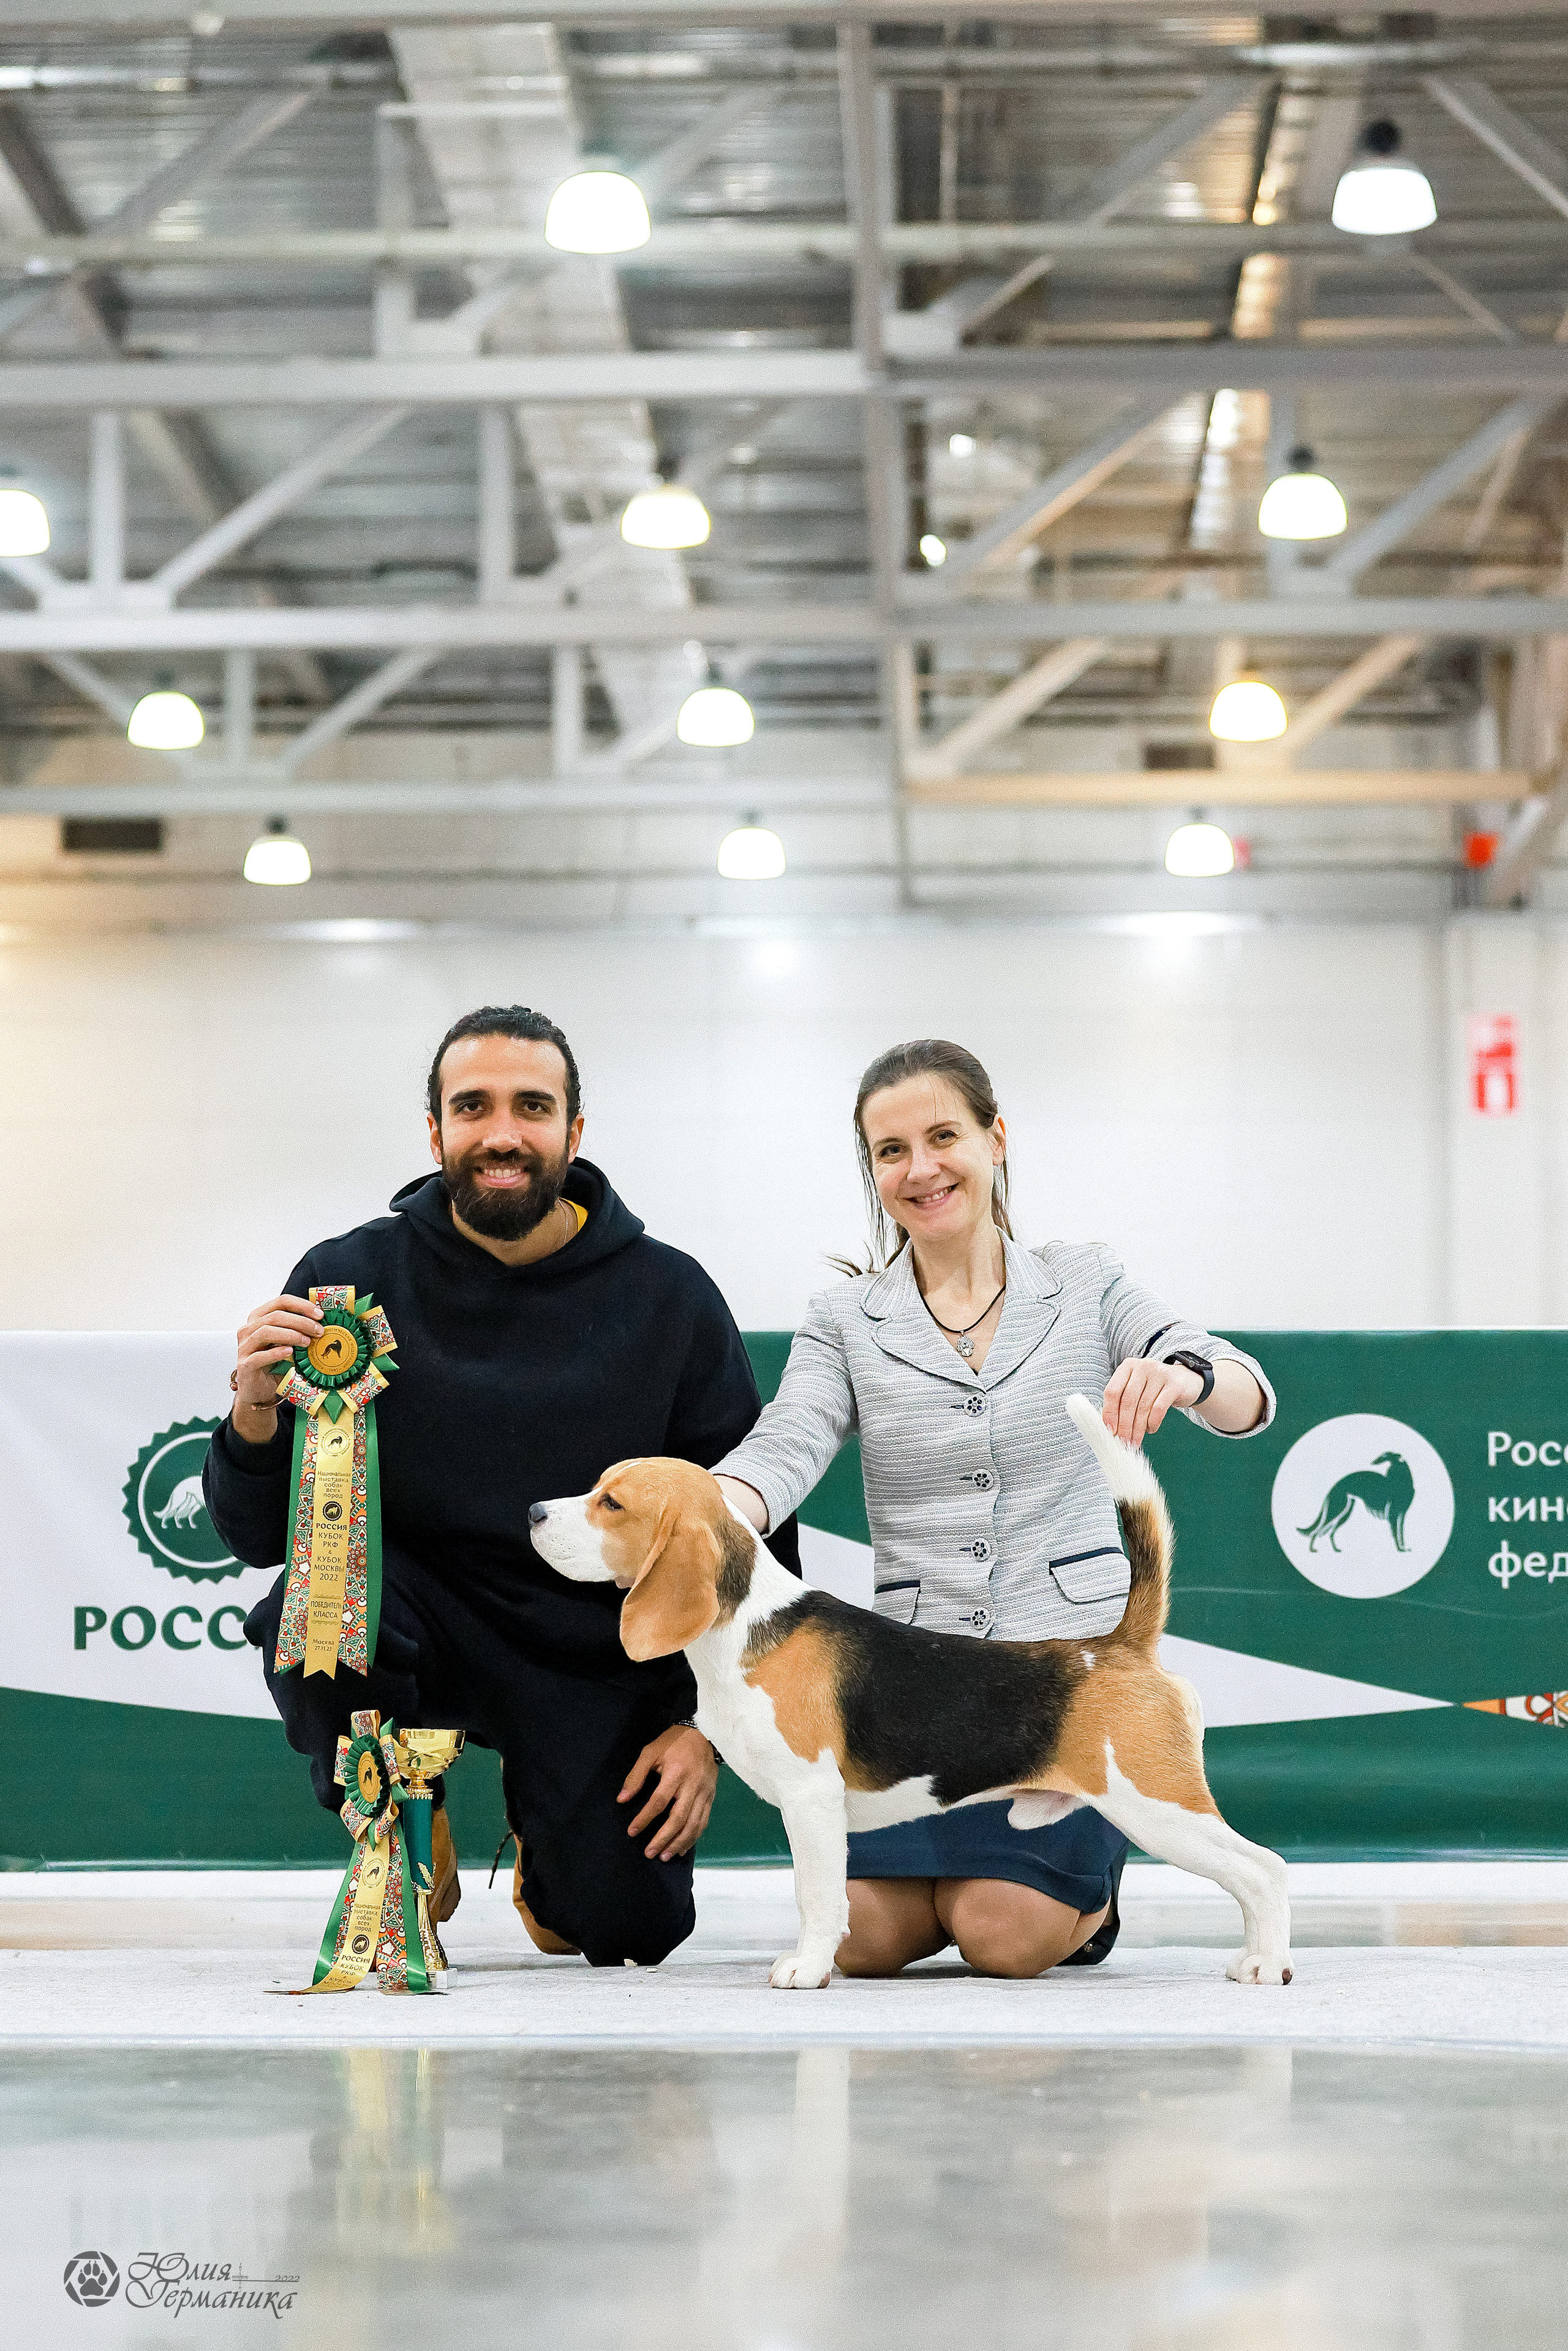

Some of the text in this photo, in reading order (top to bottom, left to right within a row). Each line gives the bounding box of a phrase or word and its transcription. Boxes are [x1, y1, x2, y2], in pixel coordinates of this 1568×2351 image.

[1488, 1431, 1568, 1467] Рос
[1488, 1496, 1568, 1522] кин
[74, 1605, 250, 1651] РОСС
[340, 1963, 364, 1971] КУБОК
[341, 1955, 371, 1964] РОССИЯ
